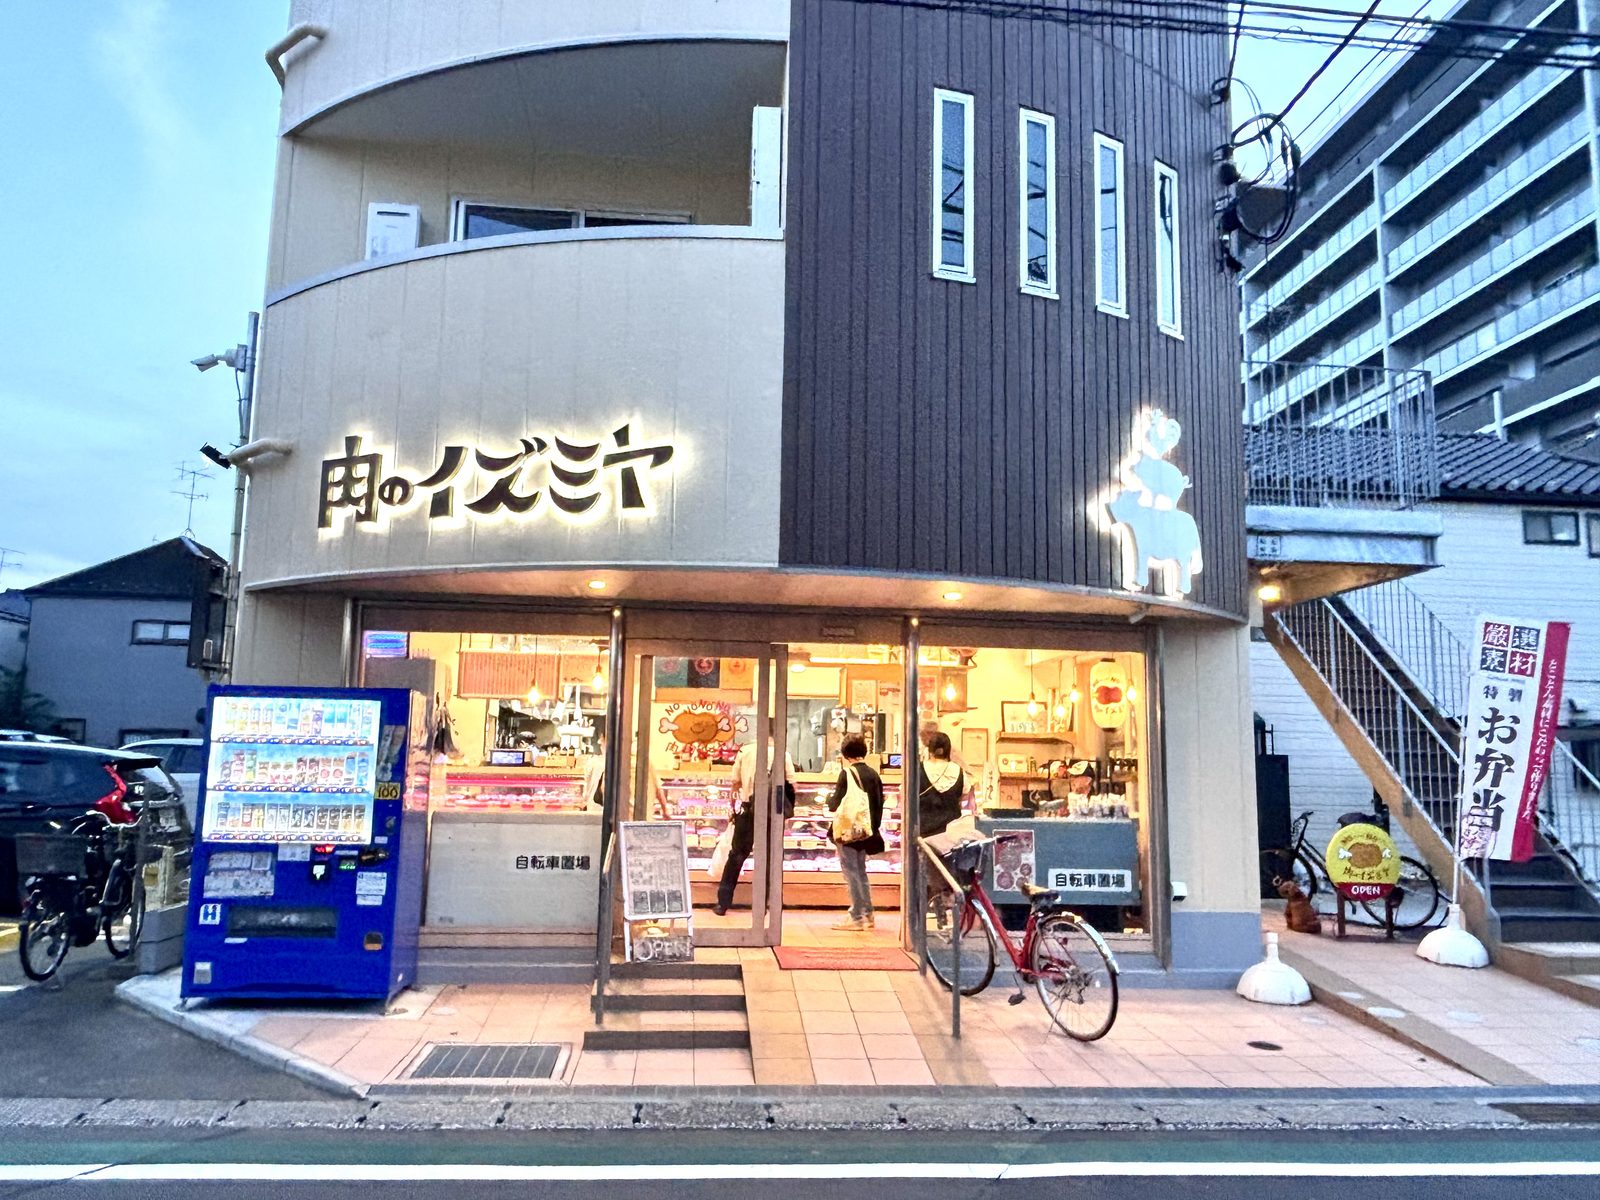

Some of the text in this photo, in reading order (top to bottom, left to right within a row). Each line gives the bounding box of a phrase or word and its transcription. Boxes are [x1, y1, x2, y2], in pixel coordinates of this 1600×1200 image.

[318, 423, 674, 528] 肉のイズミヤ
[1469, 706, 1521, 832] お弁当
[516, 854, 591, 870] 自転車置場
[1055, 872, 1126, 888] 自転車置場
[1351, 885, 1381, 895] OPEN
